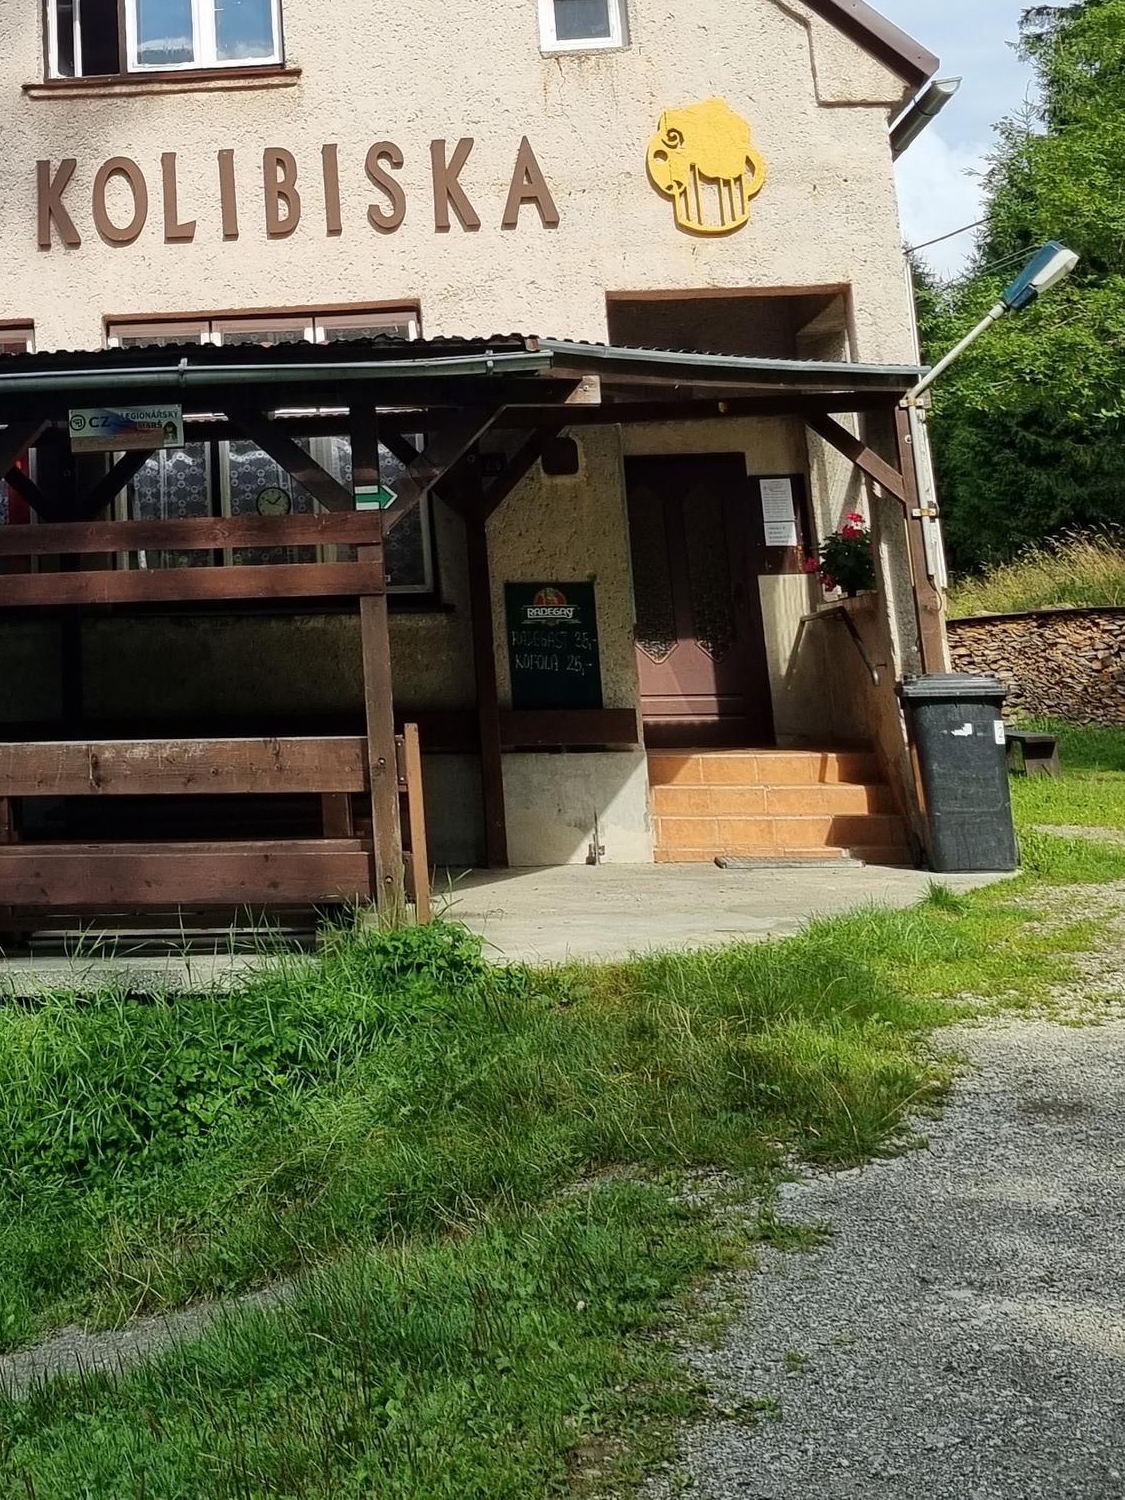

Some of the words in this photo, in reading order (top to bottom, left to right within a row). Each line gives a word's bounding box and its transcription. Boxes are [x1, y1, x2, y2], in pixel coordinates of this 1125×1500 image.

[36, 135, 560, 250] KOLIBISKA
[527, 607, 575, 619] RADEGAST
[515, 653, 559, 671] KOFOLA
